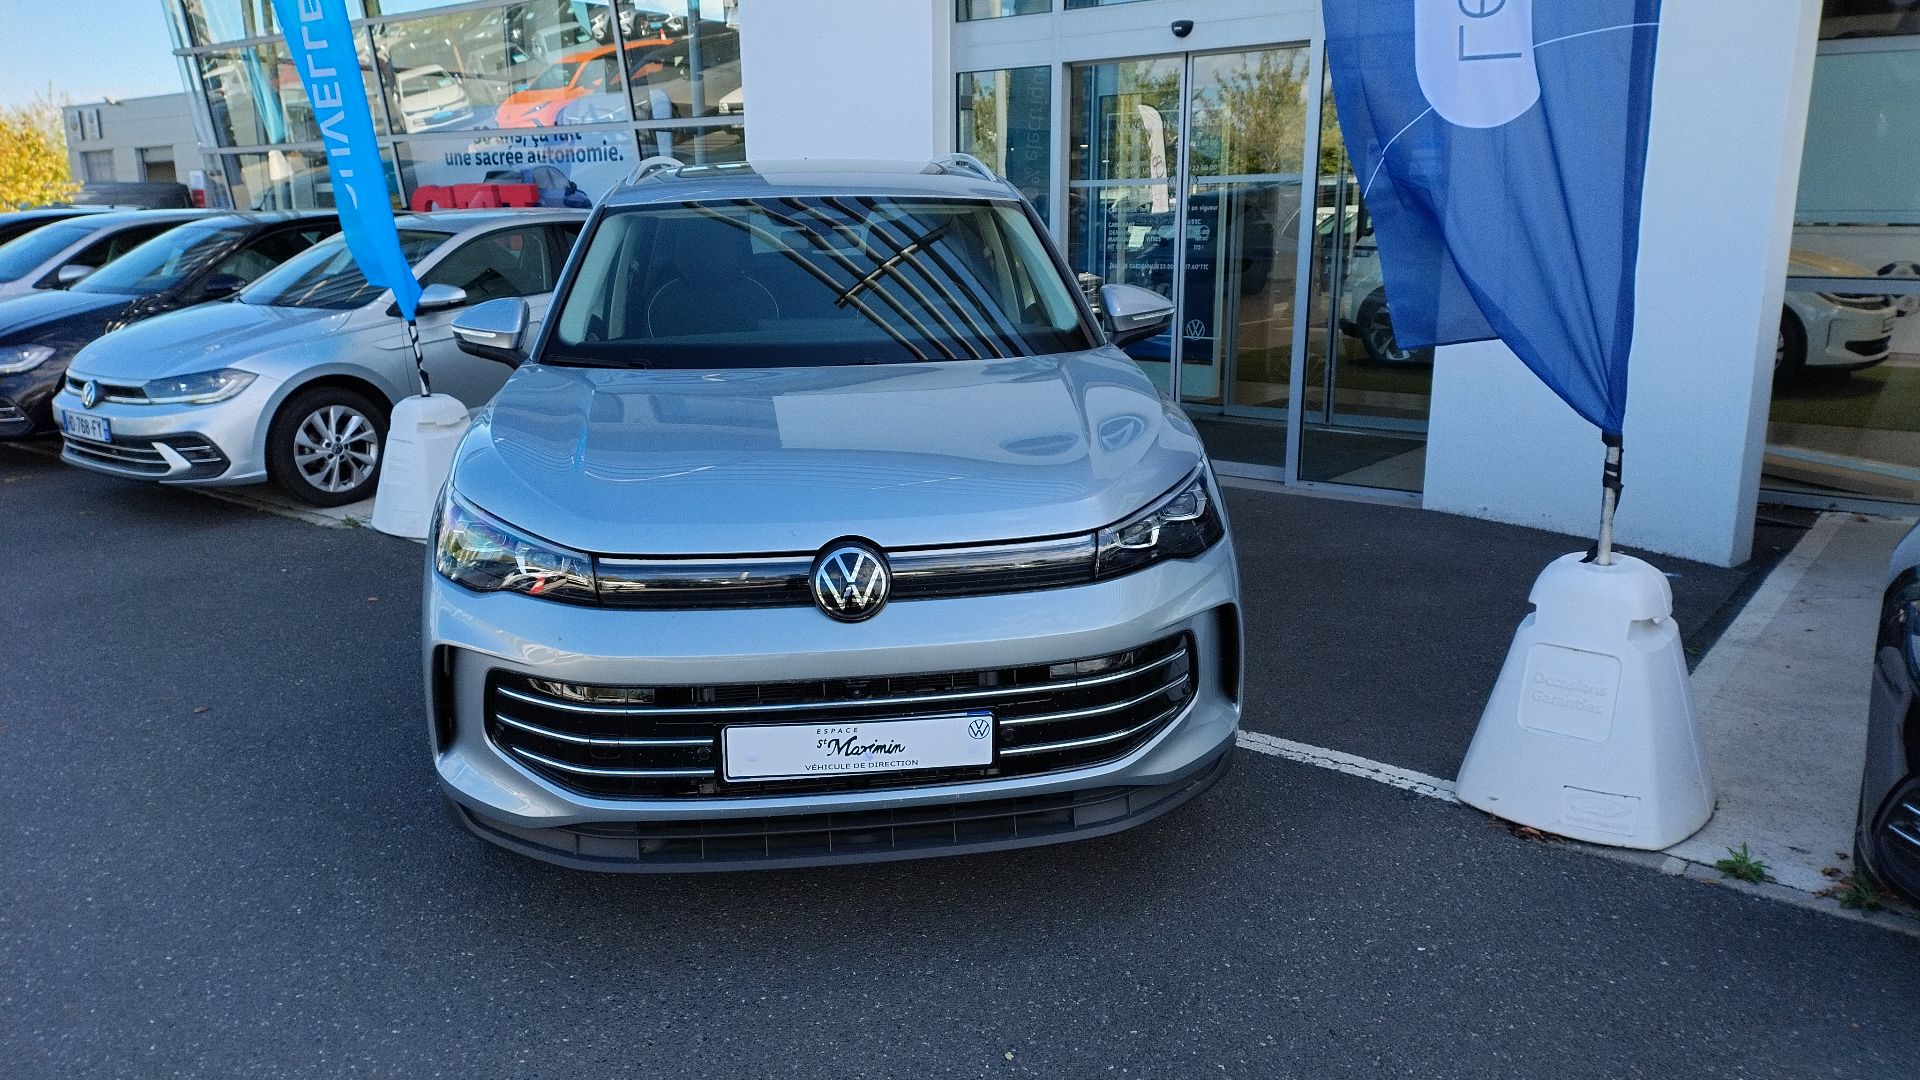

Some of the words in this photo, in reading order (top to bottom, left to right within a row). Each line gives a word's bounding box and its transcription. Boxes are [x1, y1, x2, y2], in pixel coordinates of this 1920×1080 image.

[445, 150, 471, 166] une
[475, 145, 523, 166] sacrée
[528, 140, 624, 164] autonomie.
[816, 547, 887, 614] VW
[816, 727, 859, 735] ESPACE
[827, 735, 906, 757] Maximin
[804, 763, 851, 771] VÉHICULE
[868, 759, 919, 768] DIRECTION
